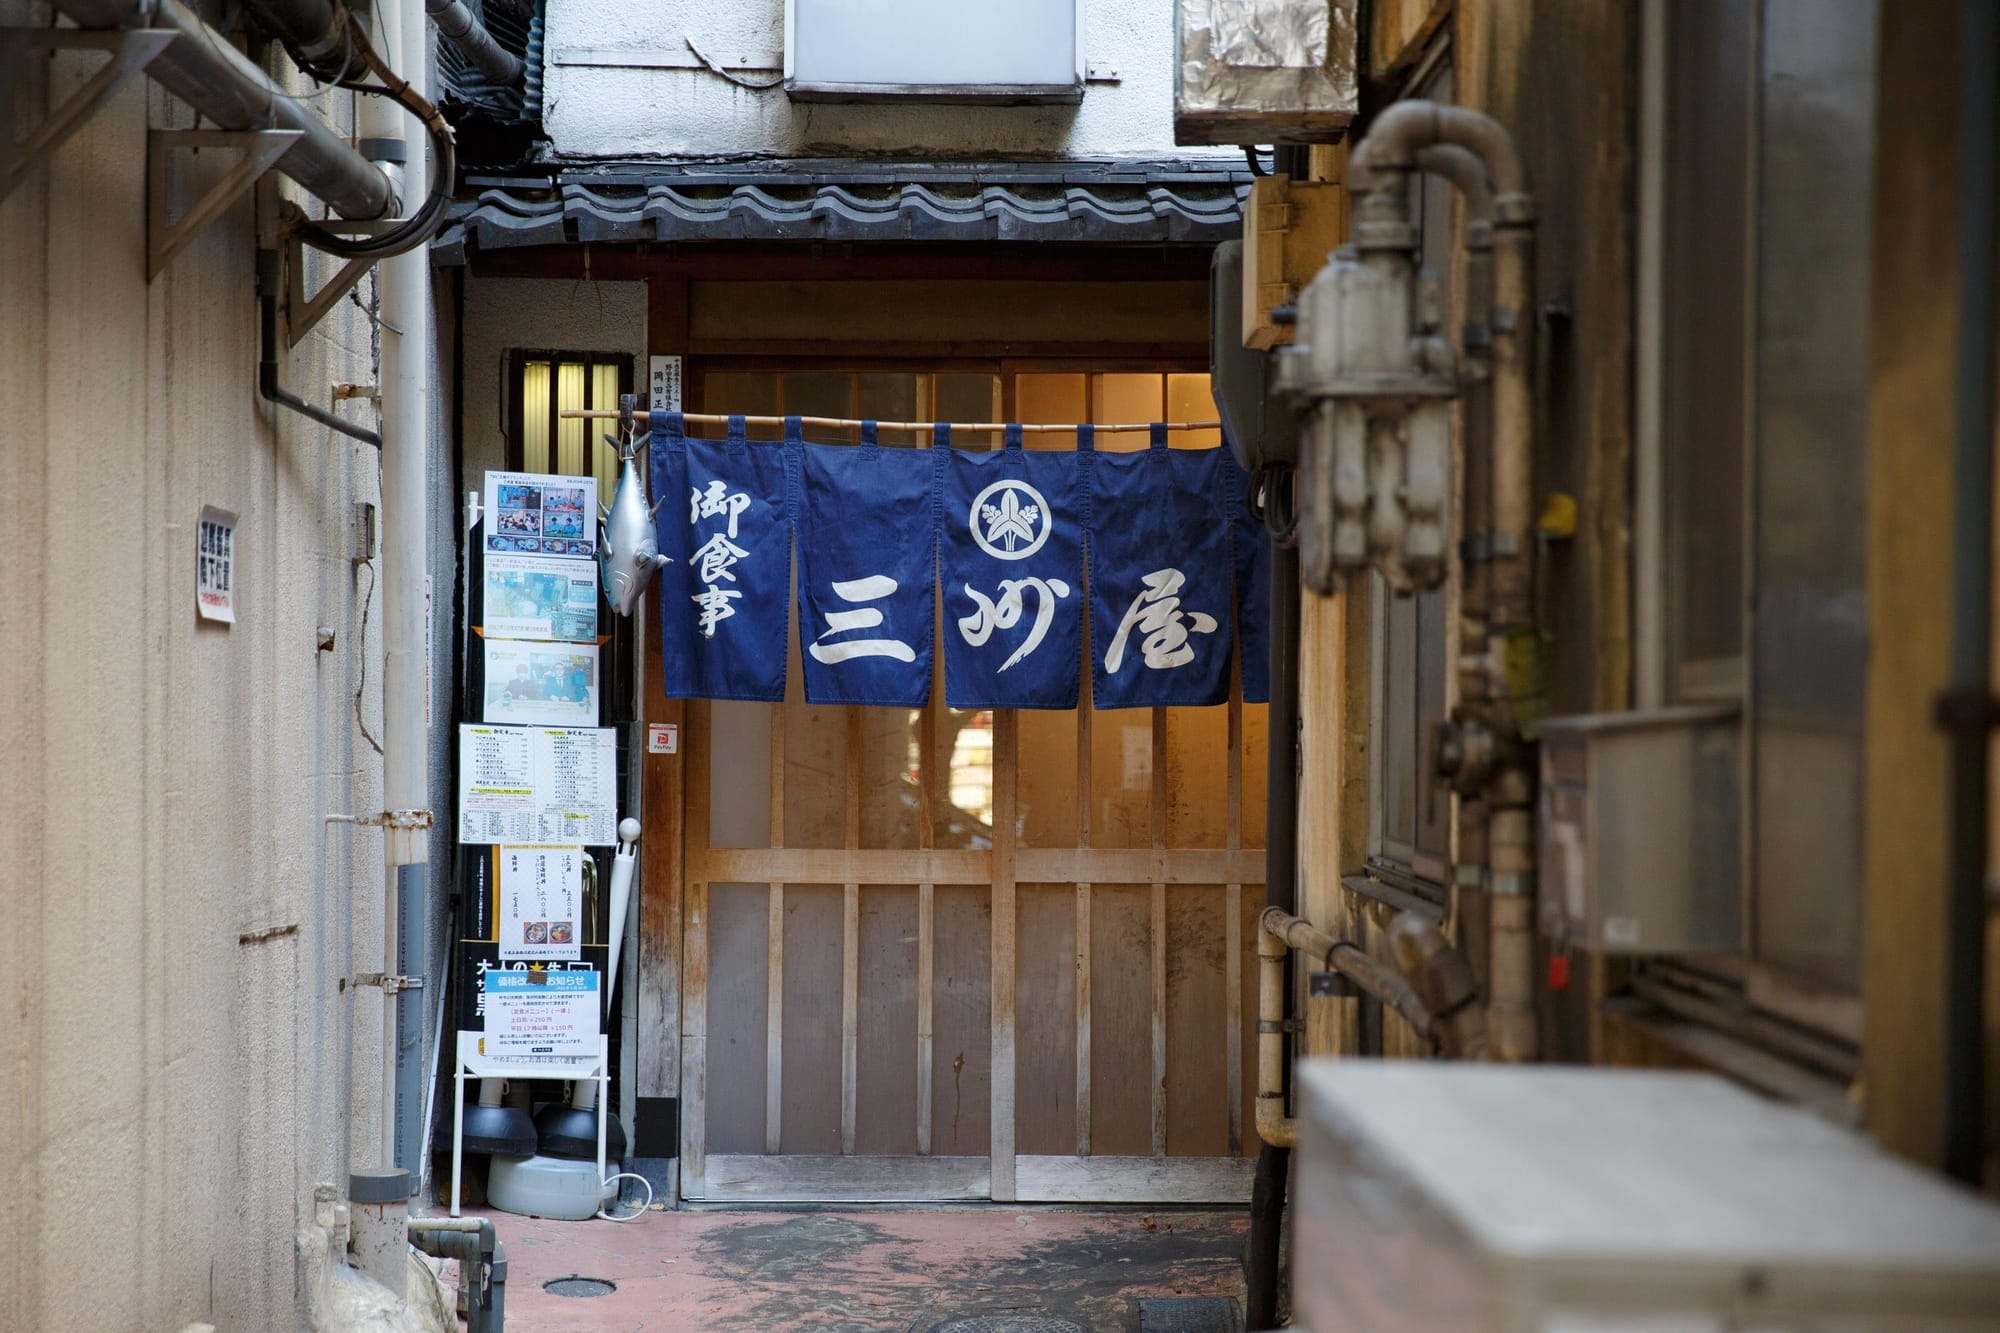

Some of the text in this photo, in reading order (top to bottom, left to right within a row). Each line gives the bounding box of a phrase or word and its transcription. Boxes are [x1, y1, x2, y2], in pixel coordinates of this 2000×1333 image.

[690, 480, 751, 639] 御食事
[498, 976, 585, 987] 価格改お知らせ
